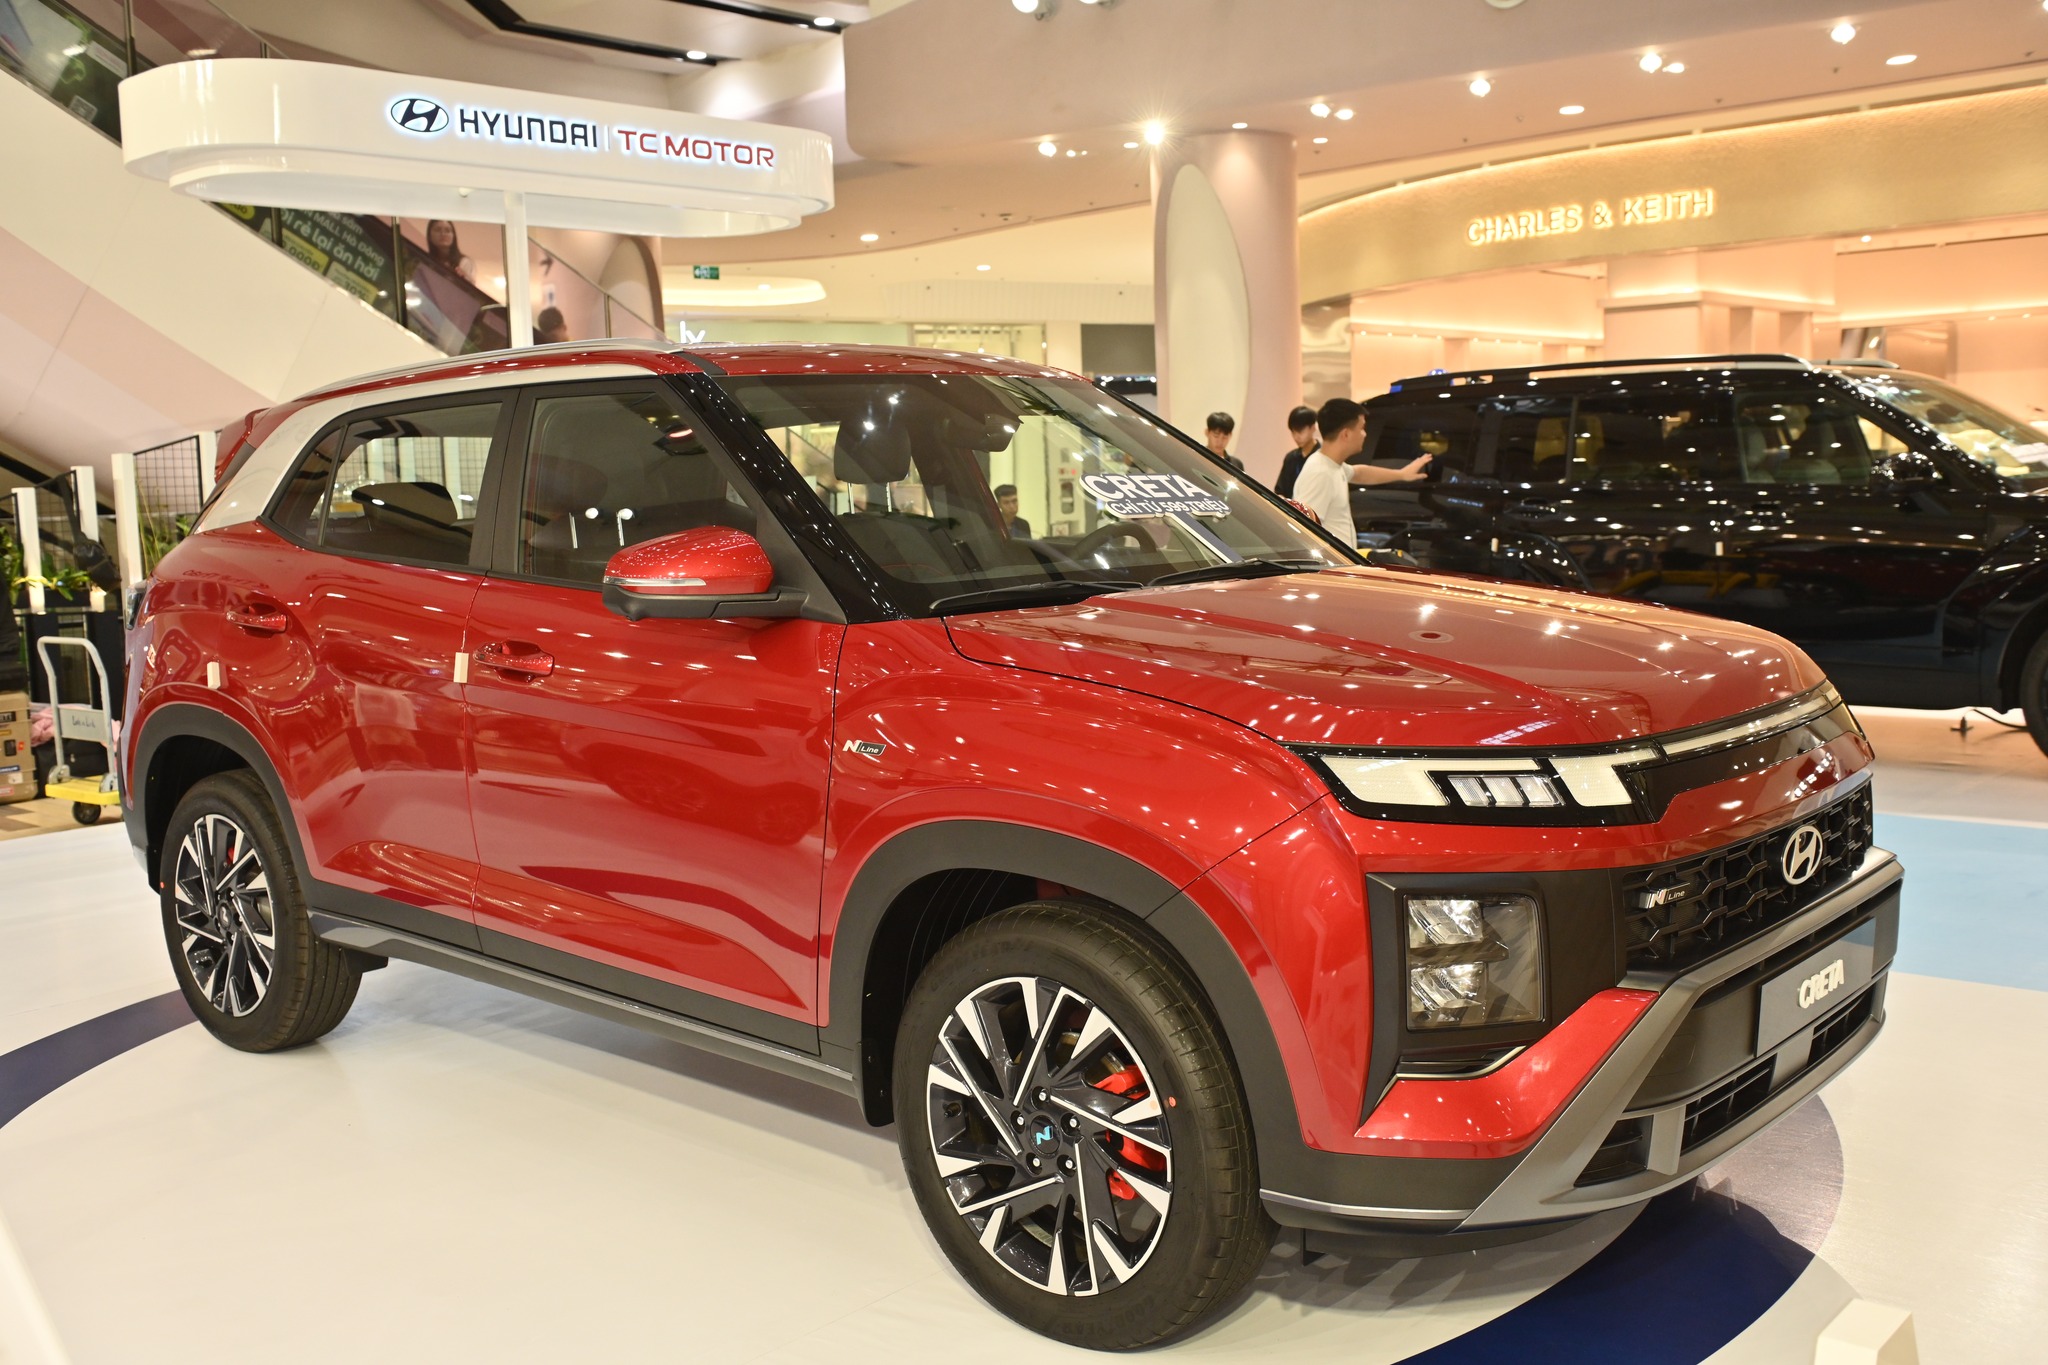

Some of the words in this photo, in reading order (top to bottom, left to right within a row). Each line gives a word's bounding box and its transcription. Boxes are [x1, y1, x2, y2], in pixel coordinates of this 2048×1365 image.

[459, 107, 598, 149] HYUNDAI
[313, 211, 340, 238] MALL
[1467, 204, 1584, 246] CHARLES
[1592, 201, 1614, 229] &
[1621, 187, 1715, 227] KEITH
[1084, 474, 1213, 500] CRETA
[1110, 499, 1143, 514] CHỈ
[1159, 501, 1189, 512] 599
[842, 740, 861, 753] N
[861, 746, 879, 754] Line
[1668, 890, 1685, 900] Line
[1798, 959, 1845, 1009] CRETA
